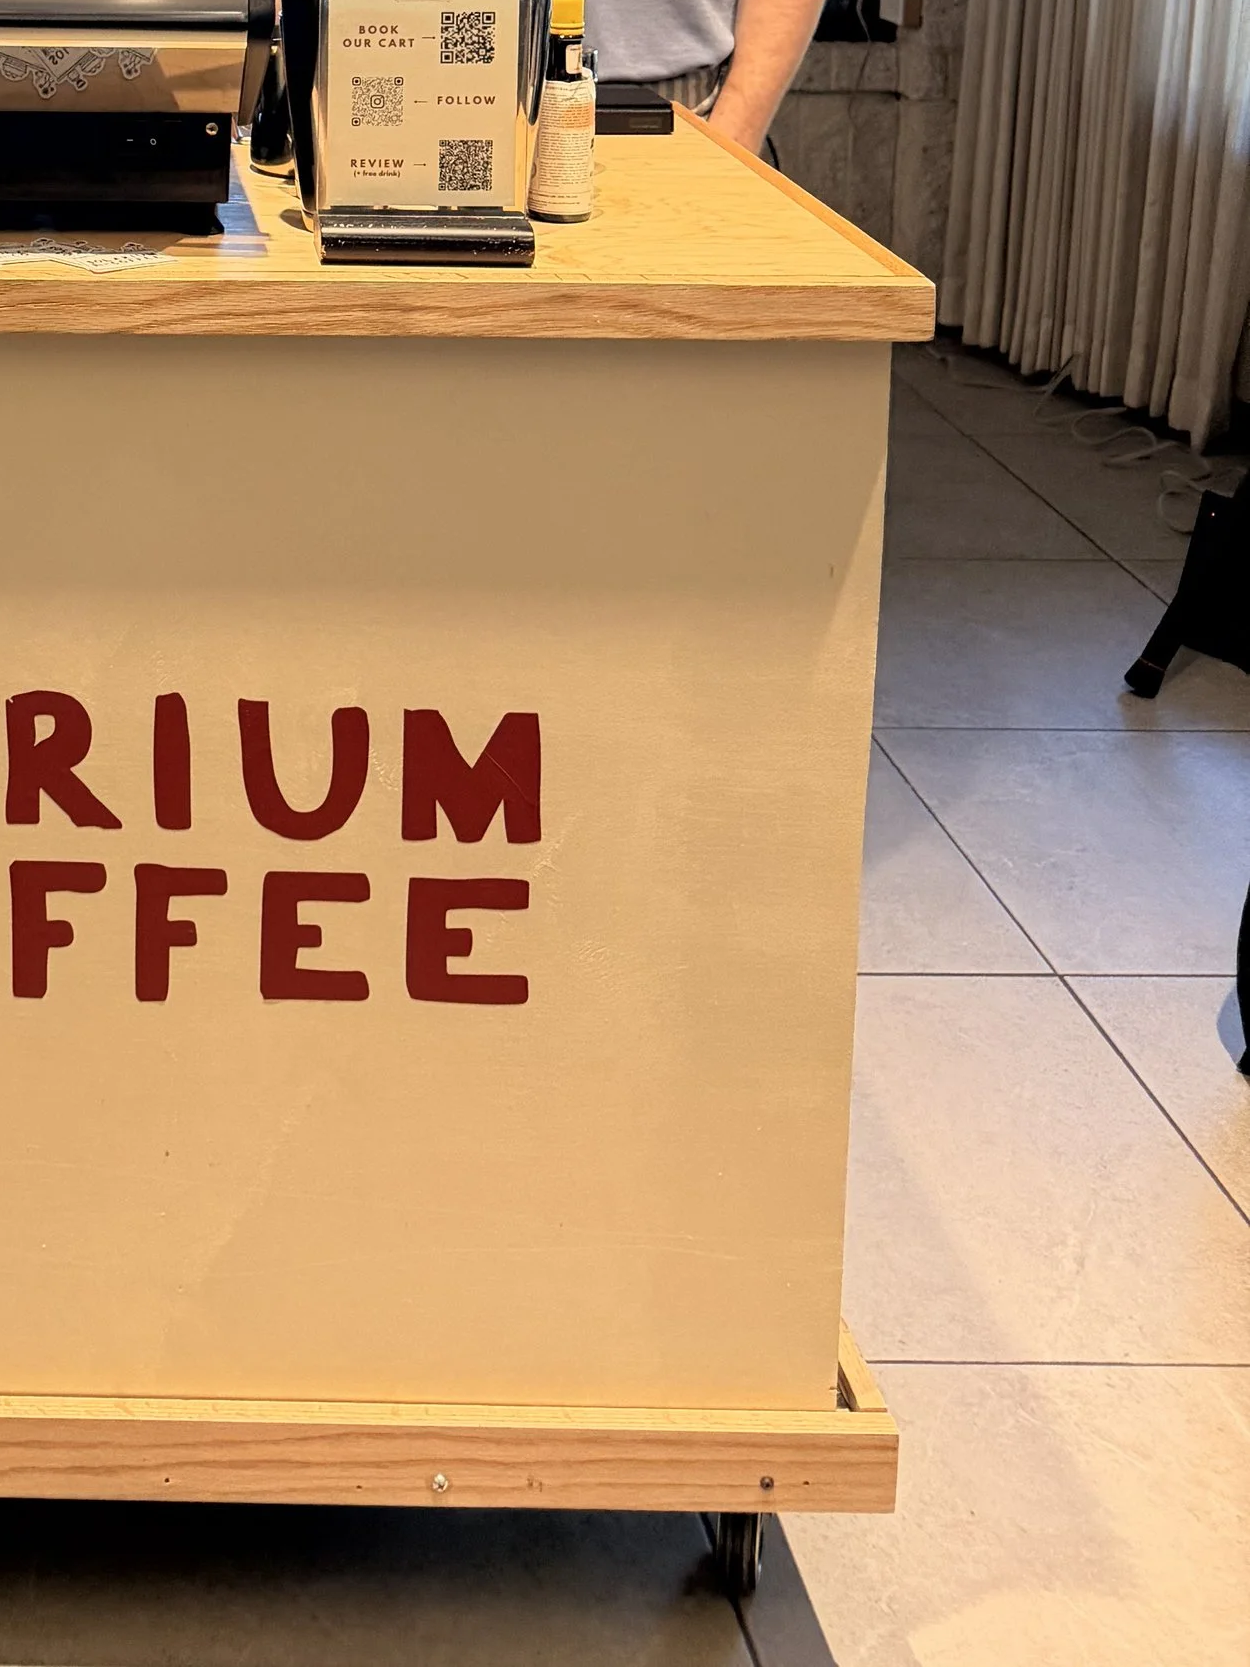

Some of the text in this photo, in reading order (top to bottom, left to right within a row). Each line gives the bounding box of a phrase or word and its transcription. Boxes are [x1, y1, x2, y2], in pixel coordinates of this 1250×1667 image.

[358, 25, 399, 35] BOOK
[342, 38, 415, 48] OUR CART
[437, 95, 496, 105] FOLLOW
[350, 158, 404, 168] REVIEW
[378, 170, 401, 178] drink)
